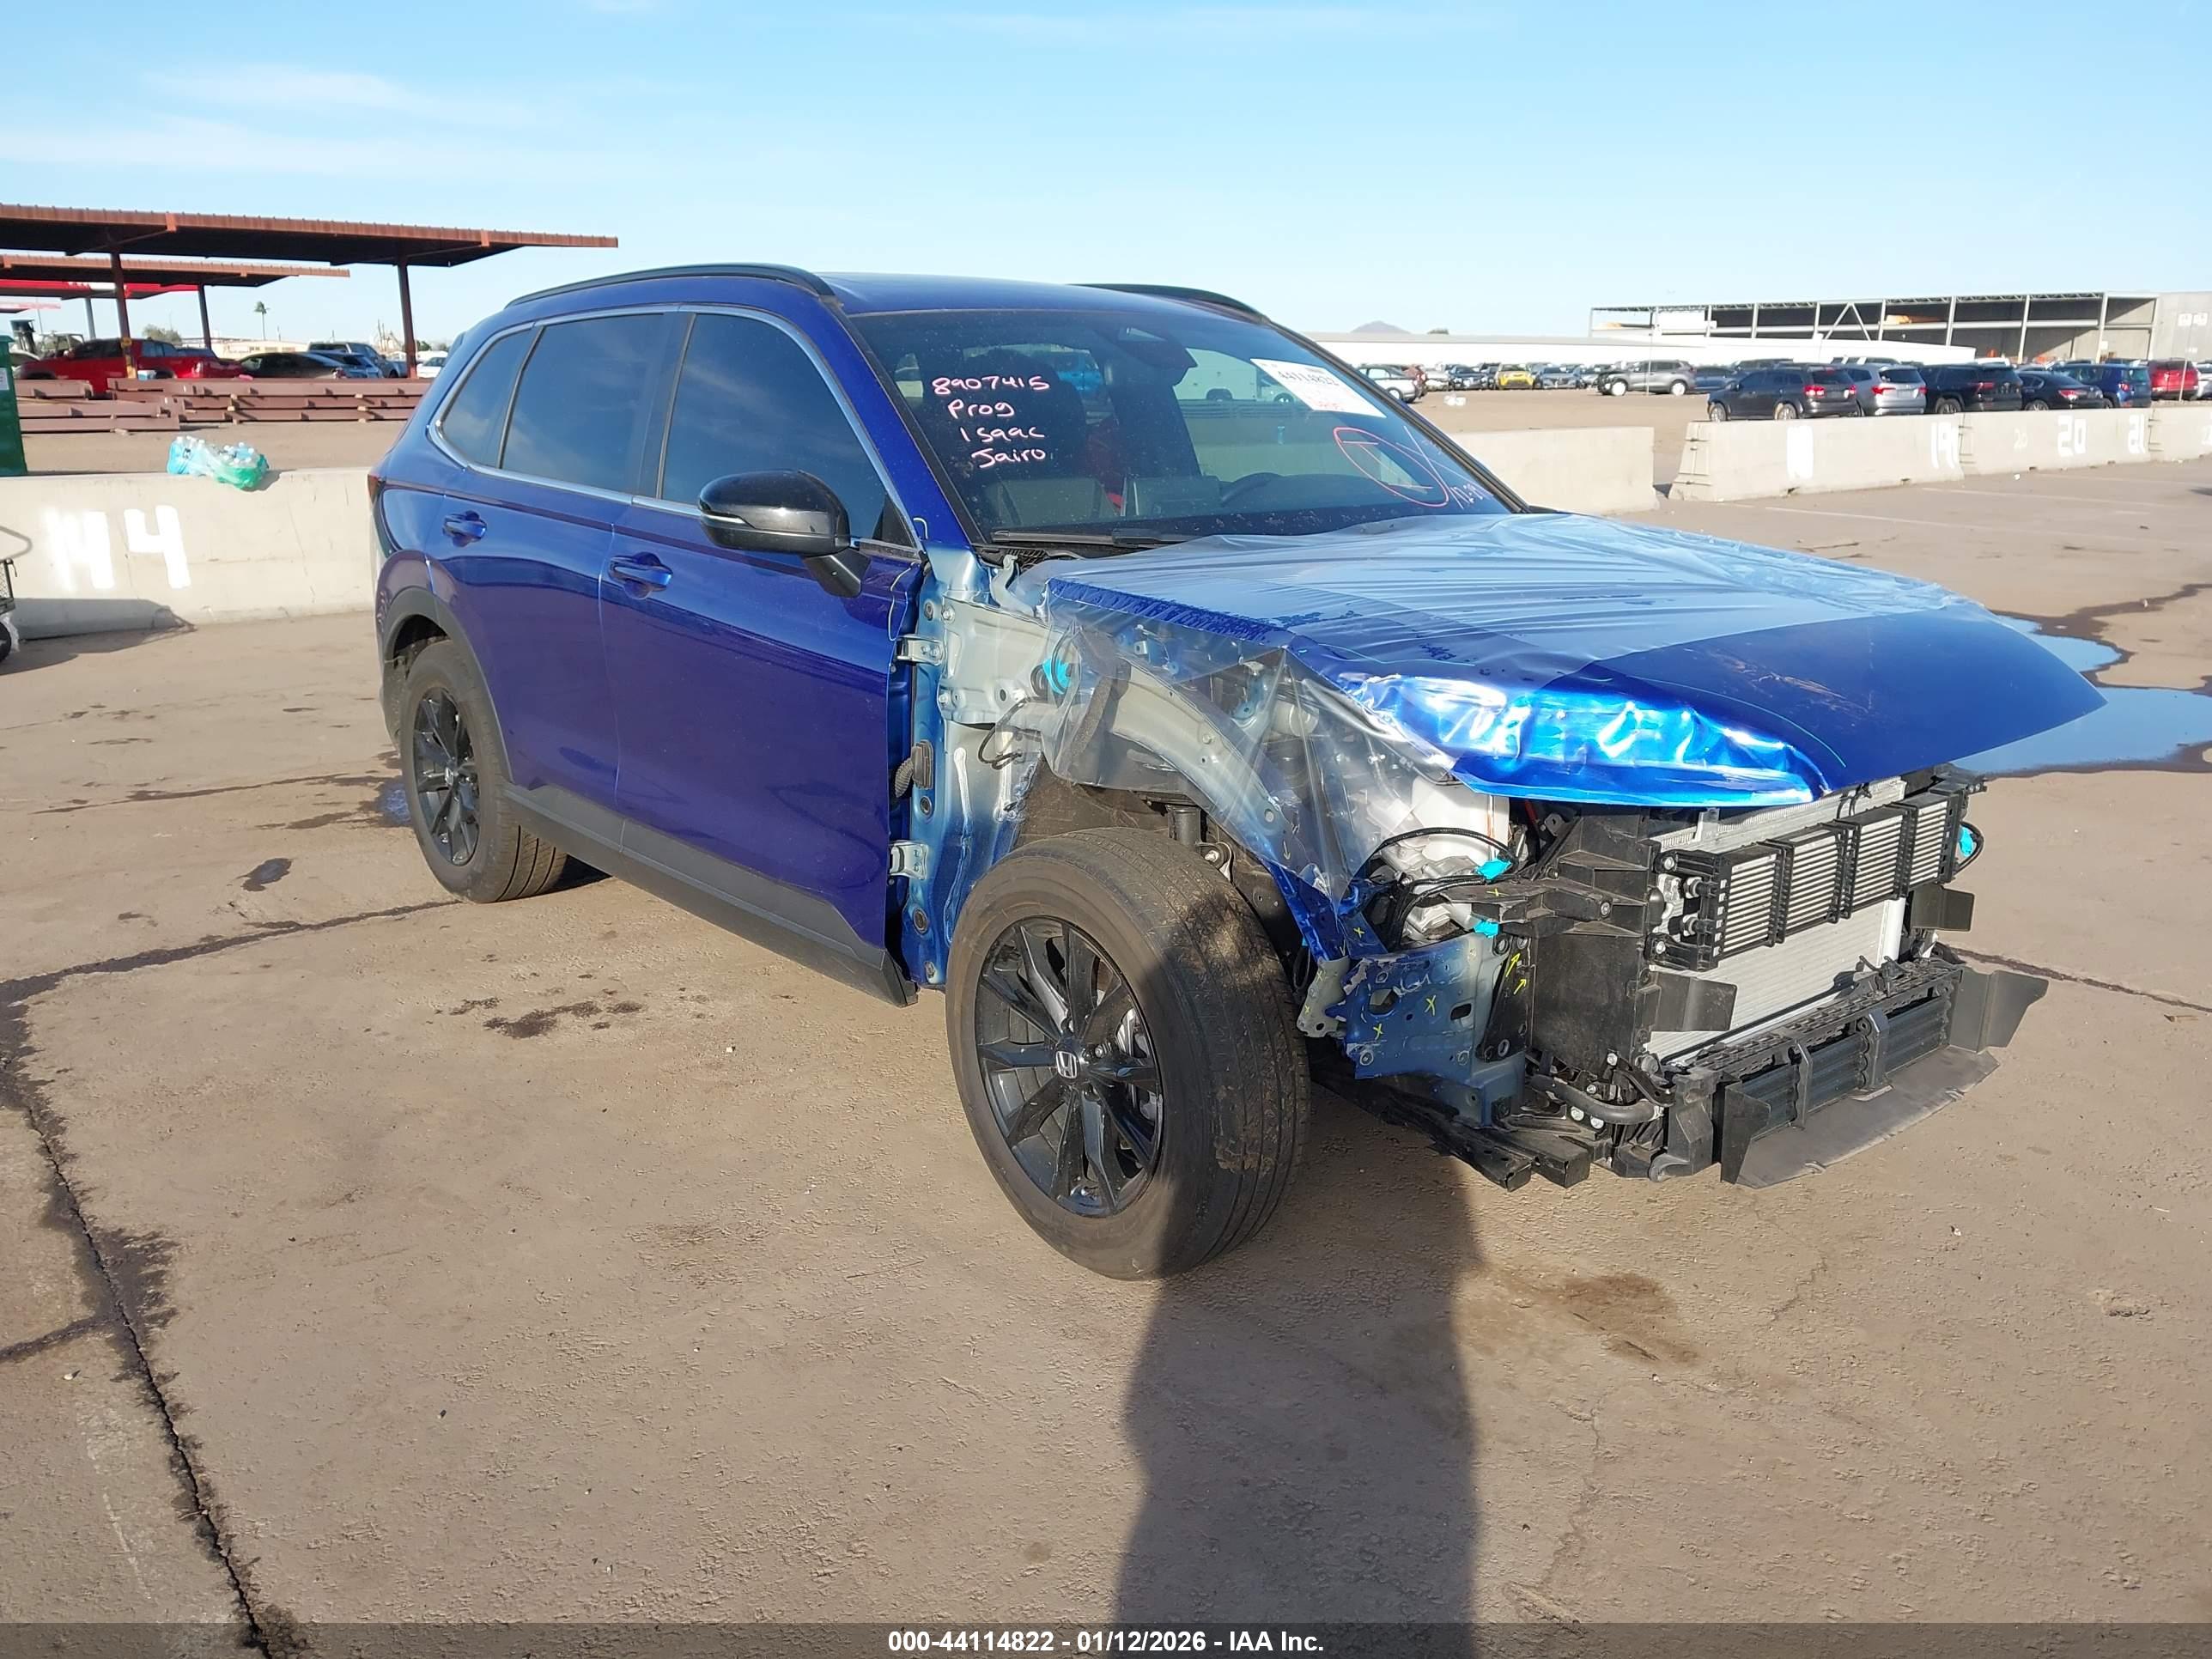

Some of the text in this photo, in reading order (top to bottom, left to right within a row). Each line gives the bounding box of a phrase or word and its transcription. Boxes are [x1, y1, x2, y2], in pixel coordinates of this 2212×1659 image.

[932, 375, 1050, 395] 8907415
[947, 398, 1015, 419] Prog
[2057, 414, 2087, 457] 20
[971, 447, 1046, 469] Jairo
